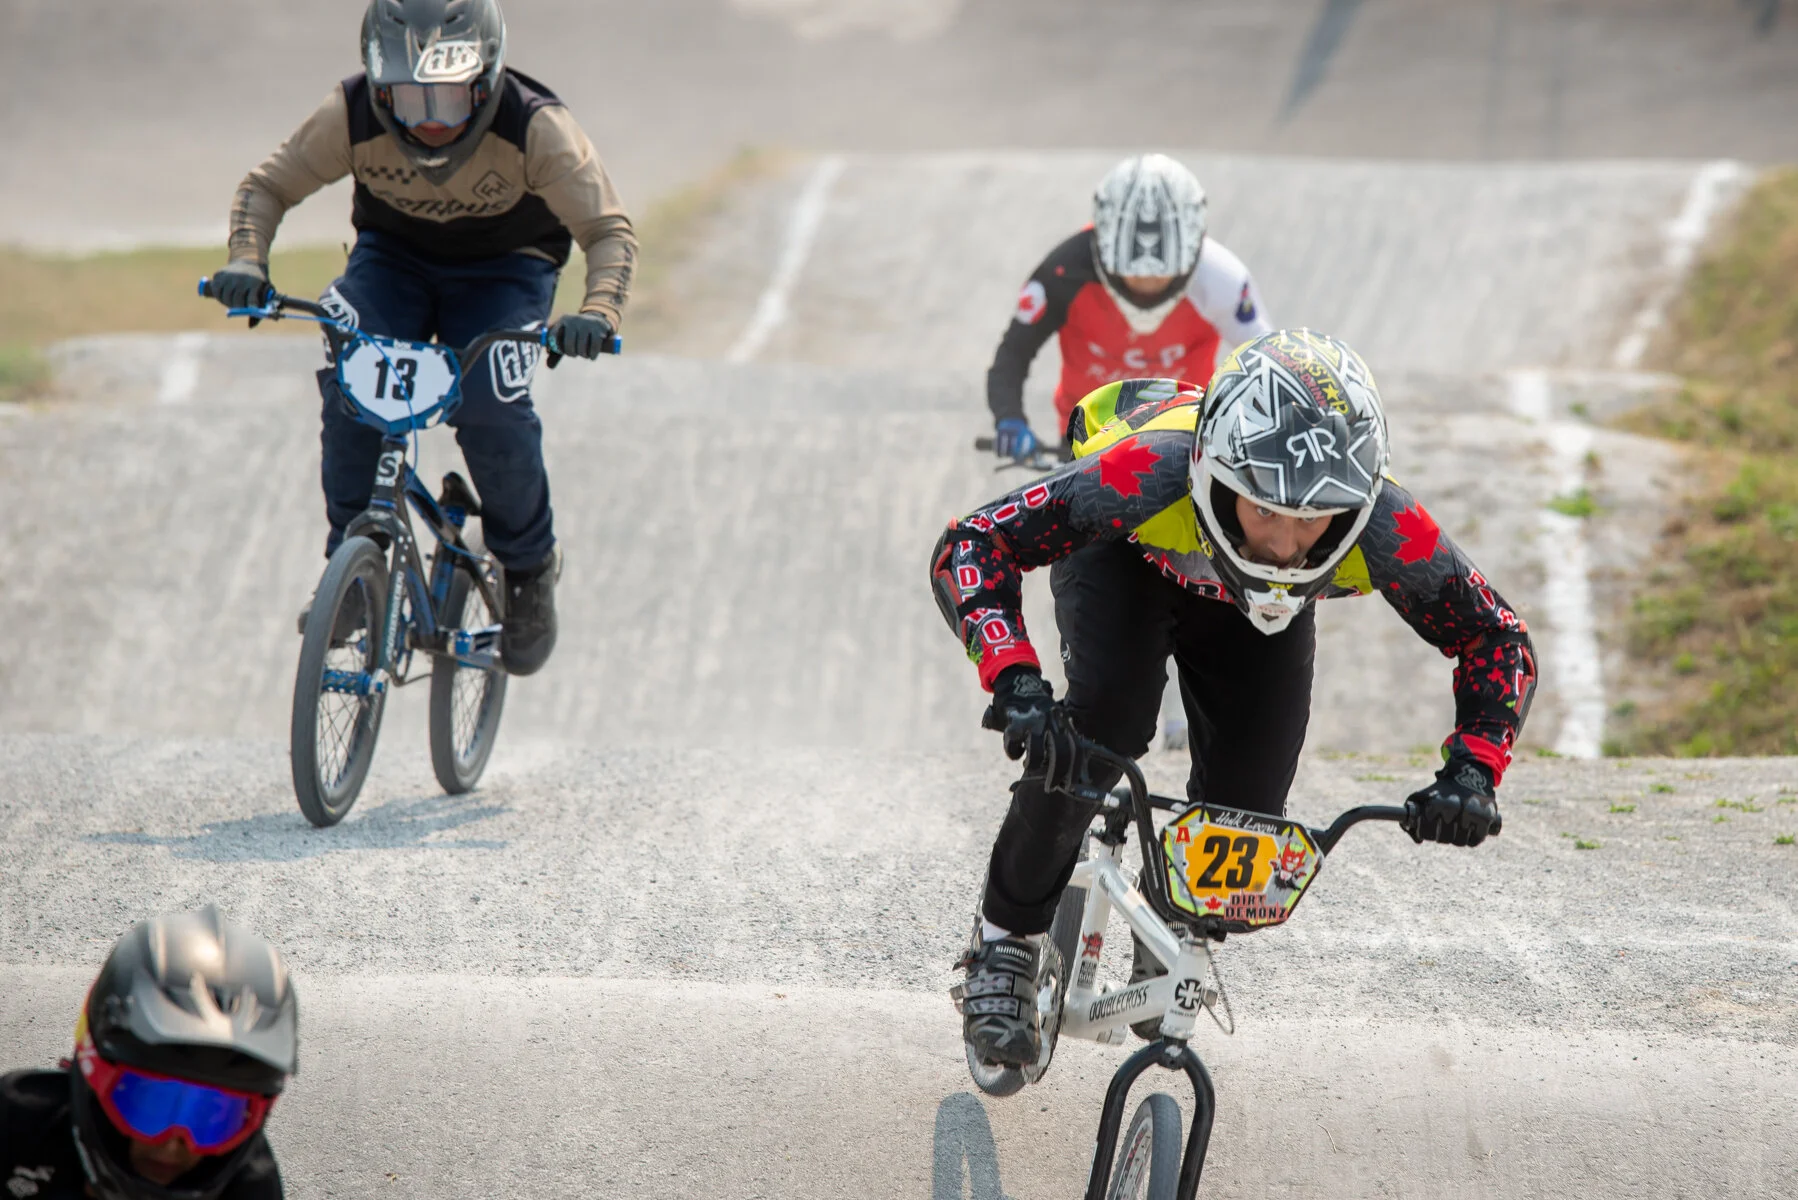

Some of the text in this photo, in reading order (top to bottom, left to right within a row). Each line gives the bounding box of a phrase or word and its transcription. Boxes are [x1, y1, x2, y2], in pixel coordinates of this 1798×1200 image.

[375, 358, 418, 400] 13
[1176, 826, 1191, 843] A
[1196, 835, 1259, 889] 23
[1230, 894, 1266, 907] DIRT
[1225, 905, 1288, 921] DEMONZ
[995, 944, 1033, 962] SHIMANO
[1089, 984, 1149, 1021] DOUBLECROSS
